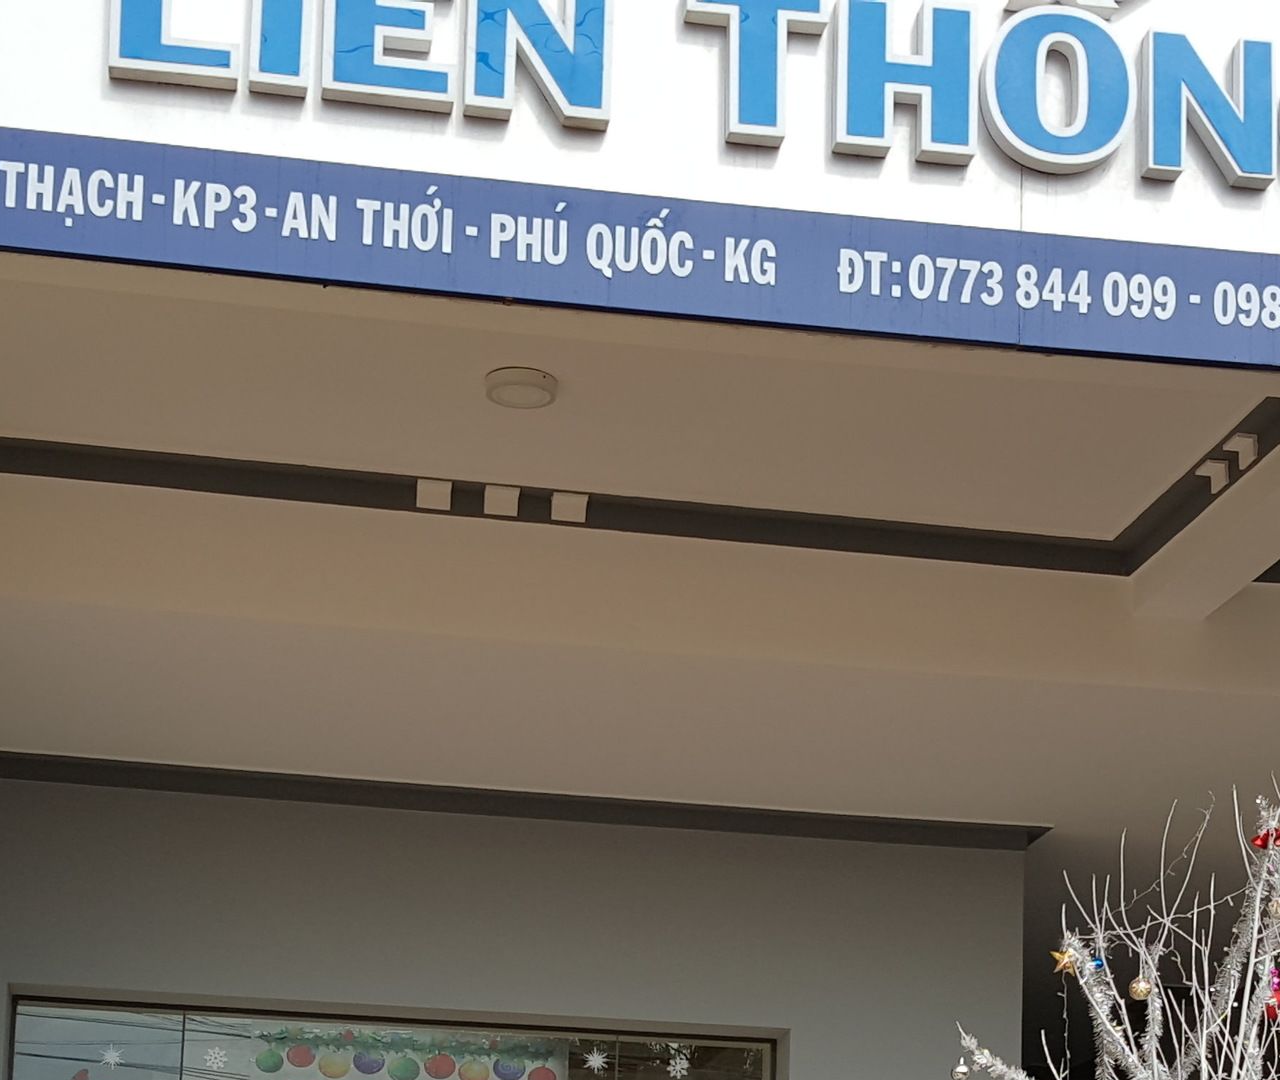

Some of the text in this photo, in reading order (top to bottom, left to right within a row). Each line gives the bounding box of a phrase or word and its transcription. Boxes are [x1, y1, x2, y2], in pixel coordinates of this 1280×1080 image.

[356, 185, 453, 254] THỚI
[490, 202, 568, 266] PHÚ
[1015, 263, 1092, 314] 844
[1102, 271, 1177, 321] 099
